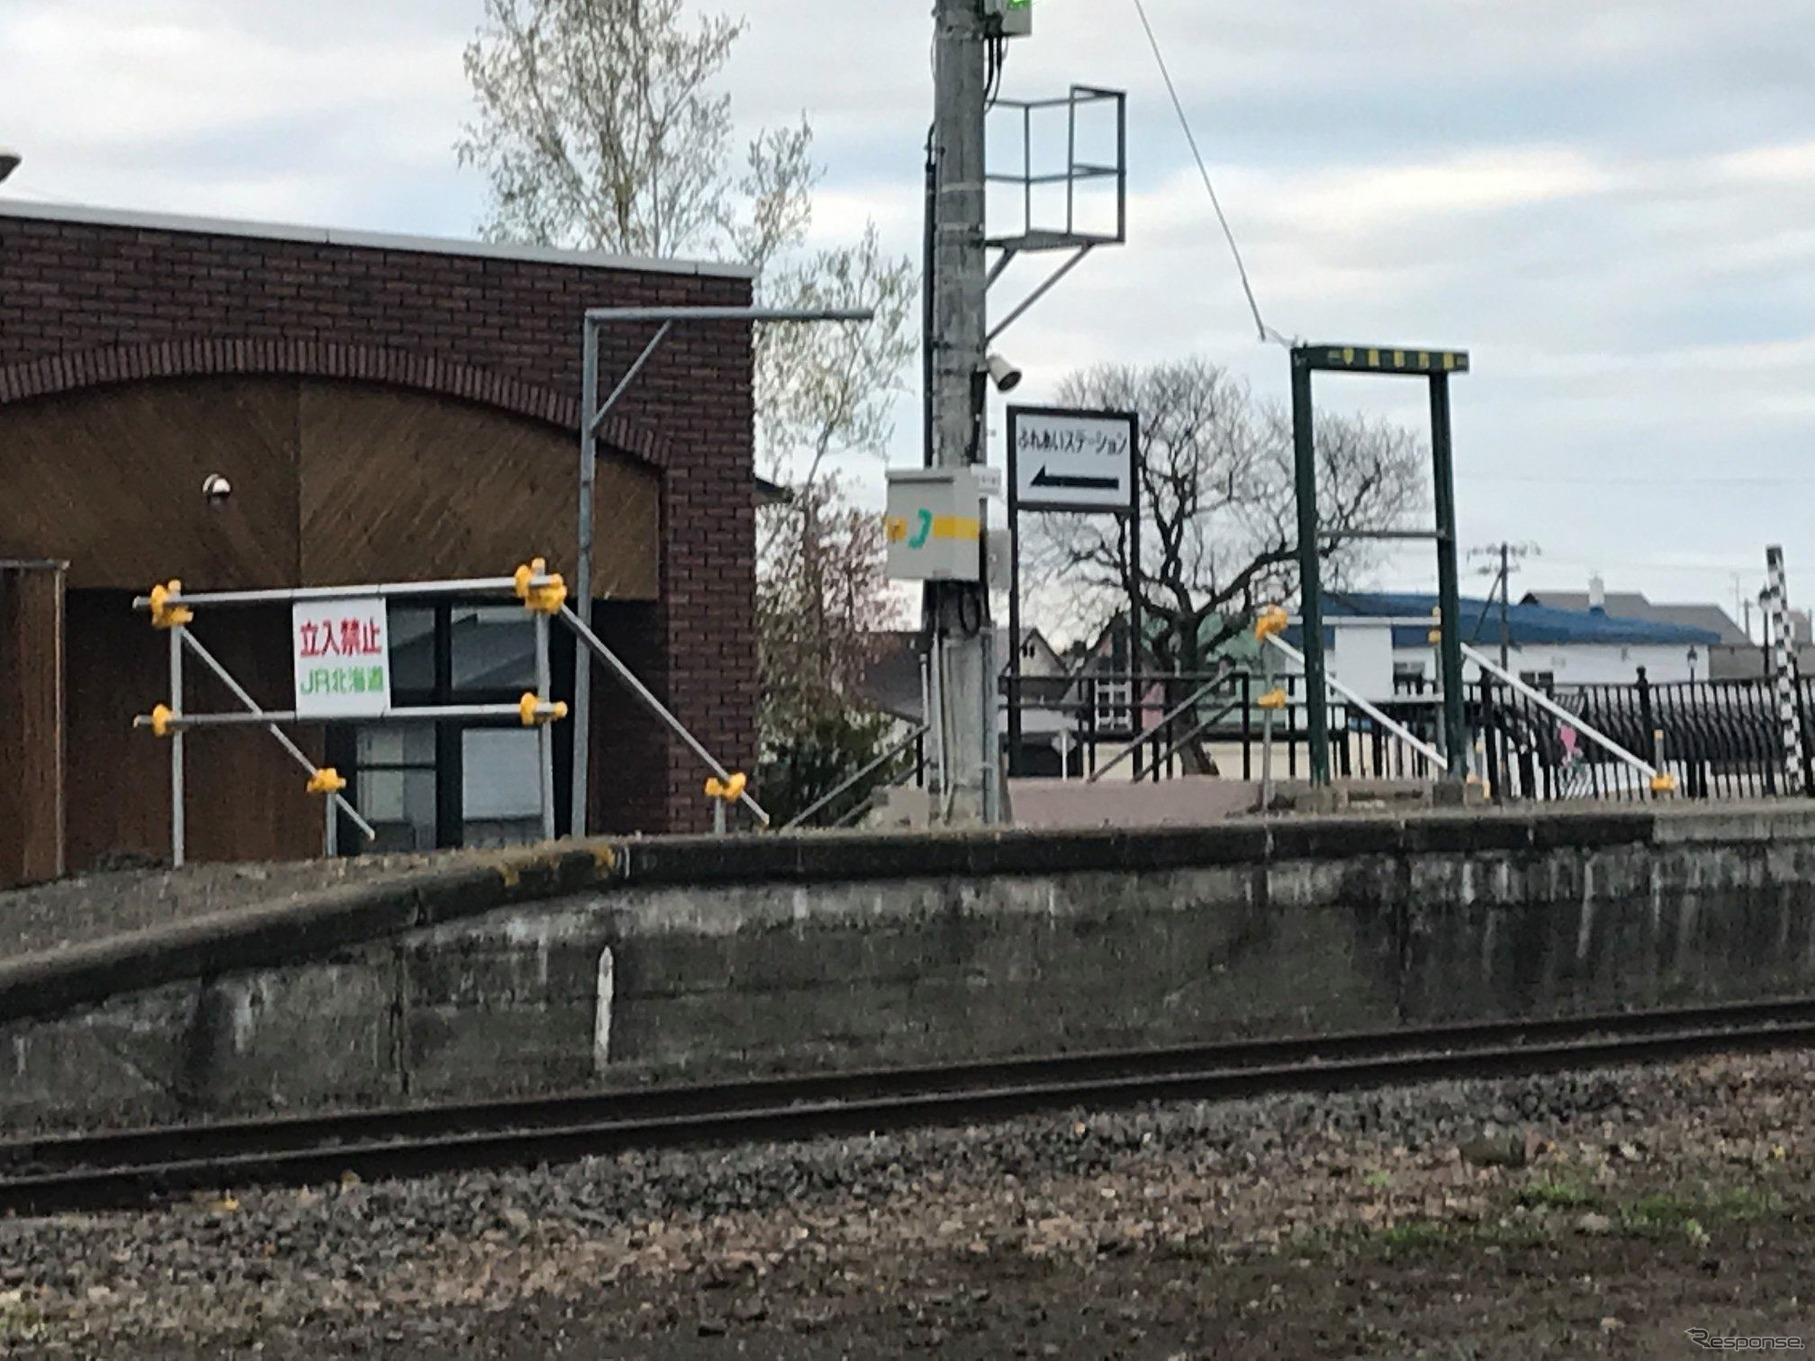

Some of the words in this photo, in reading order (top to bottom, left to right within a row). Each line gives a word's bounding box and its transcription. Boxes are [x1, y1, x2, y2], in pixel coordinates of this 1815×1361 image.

[300, 617, 382, 656] 立入禁止
[300, 666, 384, 694] JR北海道
